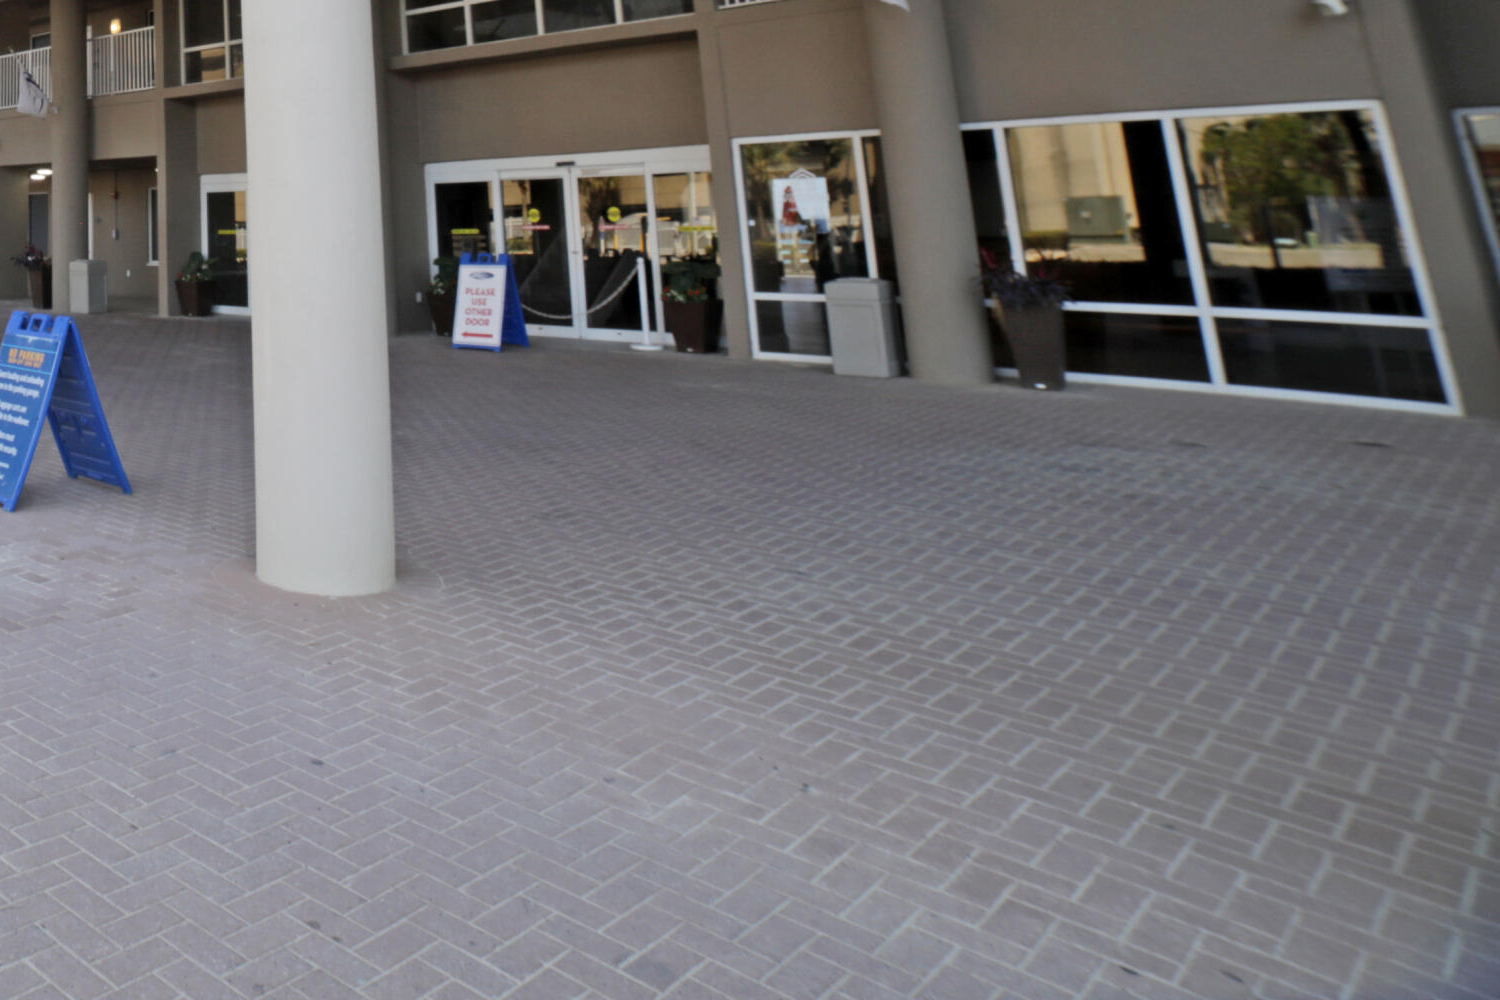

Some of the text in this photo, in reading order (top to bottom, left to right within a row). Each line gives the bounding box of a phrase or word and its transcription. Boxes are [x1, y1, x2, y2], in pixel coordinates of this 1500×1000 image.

[465, 287, 496, 297] PLEASE
[471, 298, 488, 306] USE
[464, 307, 493, 317] OTHER
[465, 317, 491, 327] DOOR
